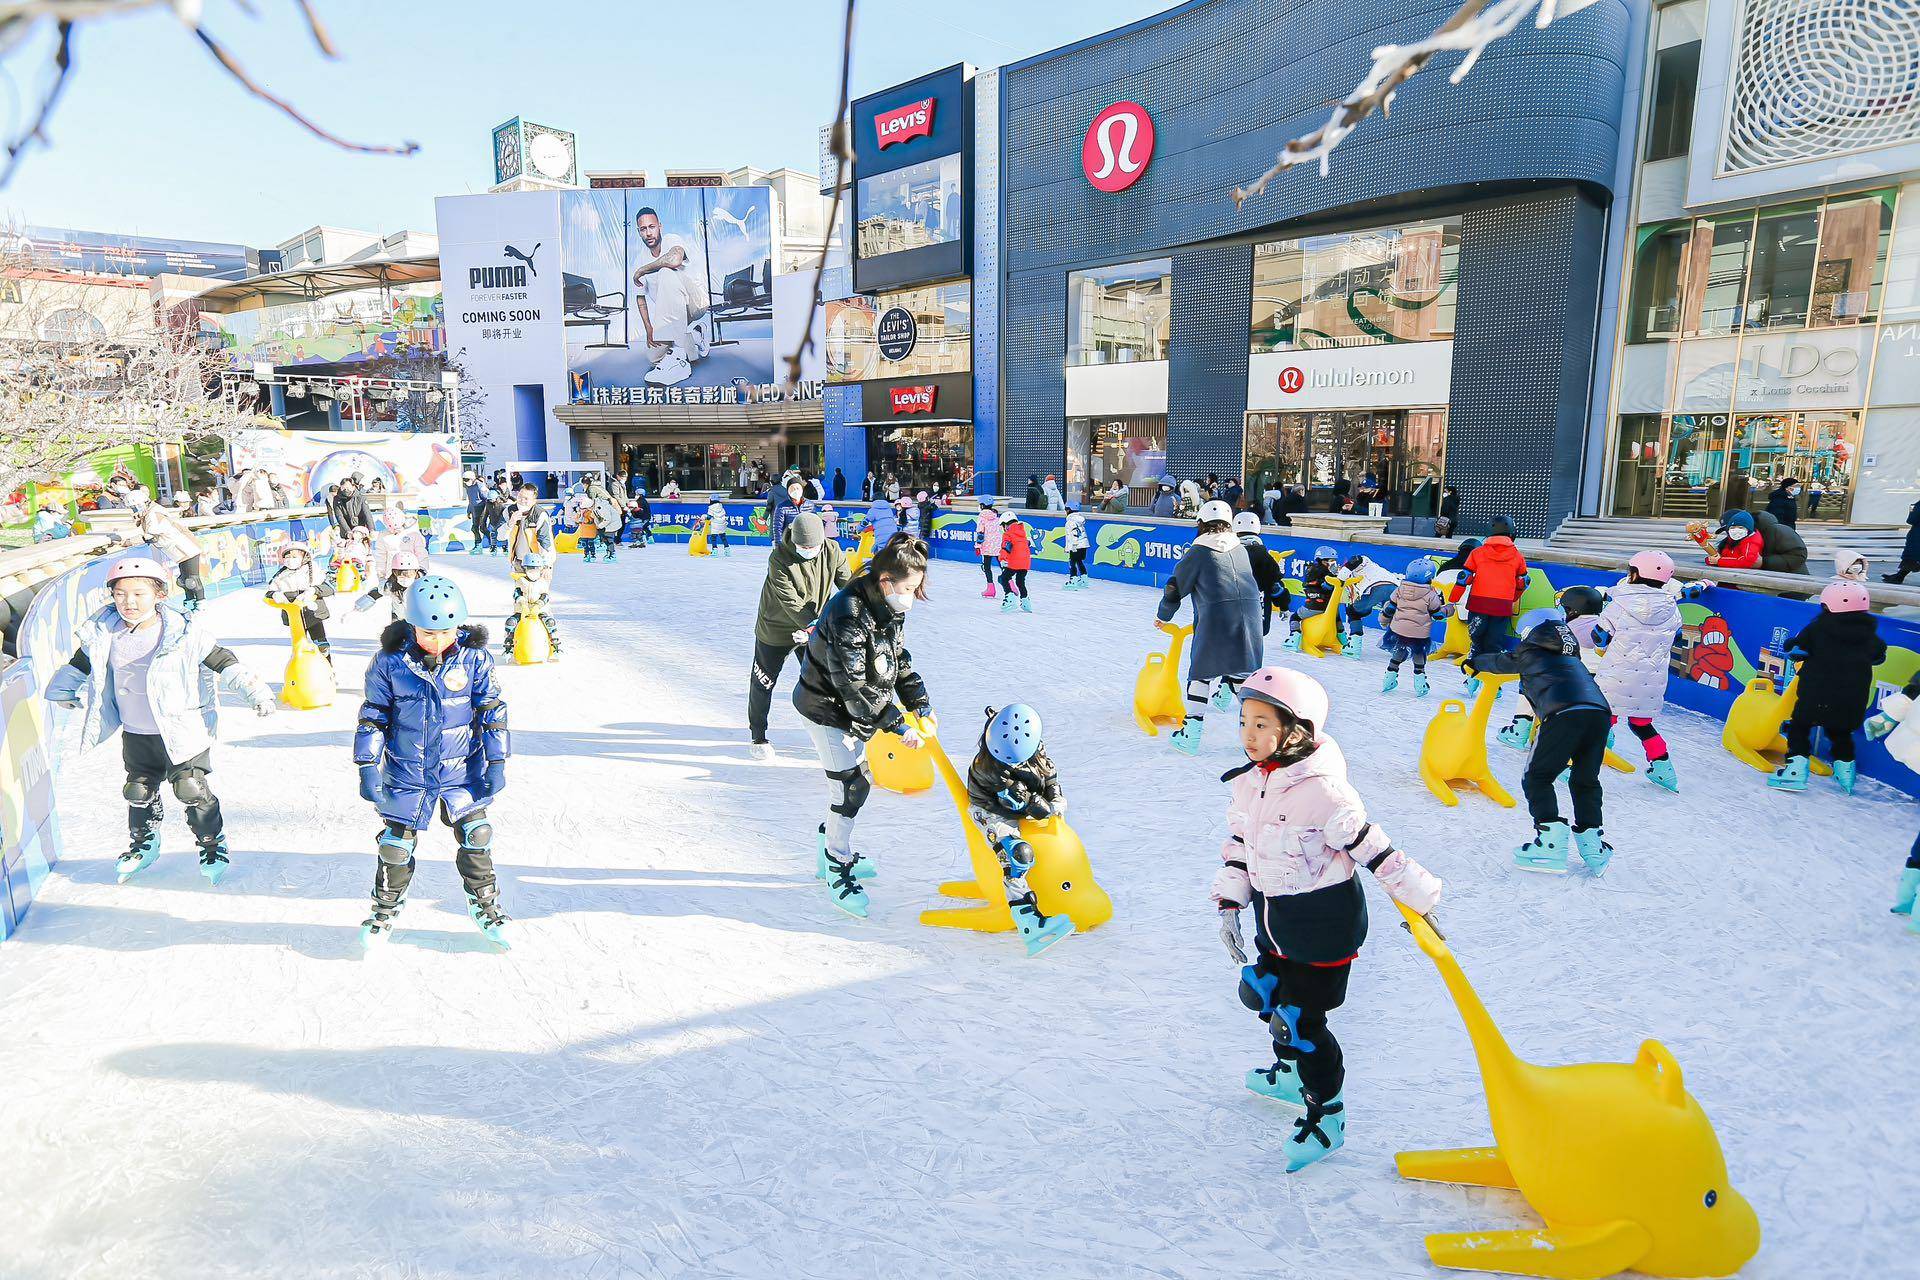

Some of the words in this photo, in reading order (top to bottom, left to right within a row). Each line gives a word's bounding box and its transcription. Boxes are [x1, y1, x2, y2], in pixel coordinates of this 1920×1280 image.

[469, 266, 527, 290] PUMA
[462, 311, 507, 324] COMING
[509, 309, 541, 322] SOON
[889, 311, 900, 320] THE
[882, 319, 908, 333] LEVI'S
[482, 328, 522, 340] 即将开业
[897, 332, 910, 341] SHOP
[1310, 367, 1416, 388] lululemon
[949, 529, 973, 542] SHINE
